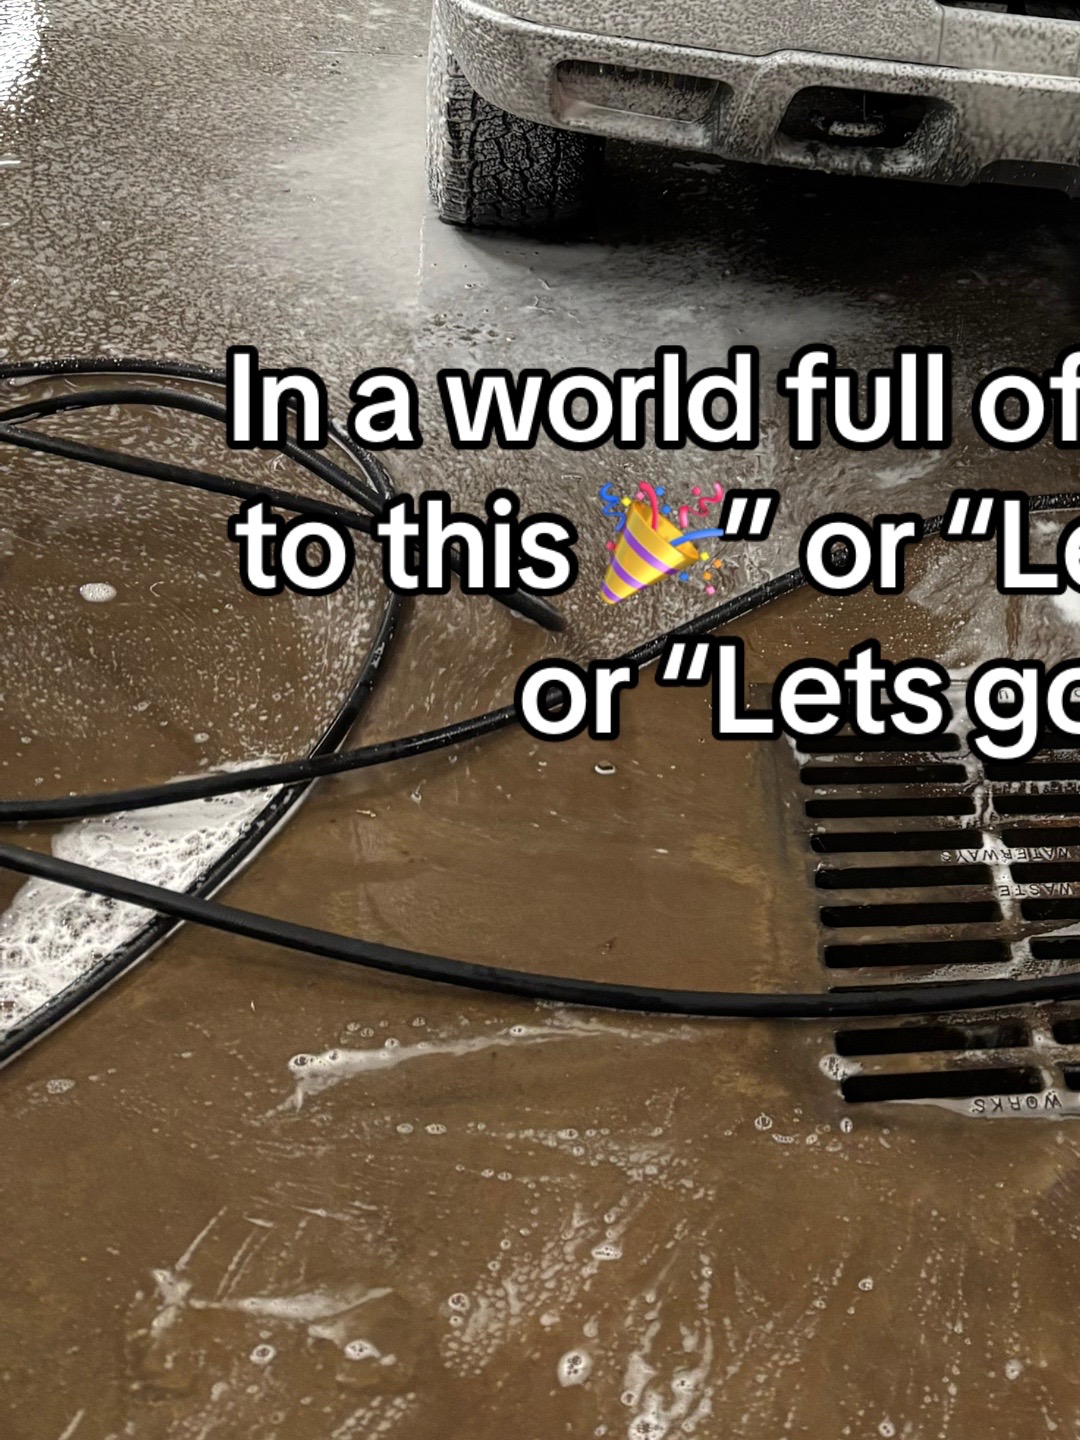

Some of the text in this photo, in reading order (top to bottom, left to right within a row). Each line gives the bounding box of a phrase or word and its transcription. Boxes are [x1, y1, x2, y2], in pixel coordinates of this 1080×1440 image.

[940, 846, 1072, 862] WATERWAYS
[999, 883, 1074, 897] WASTE
[971, 1093, 1063, 1113] WORKS
